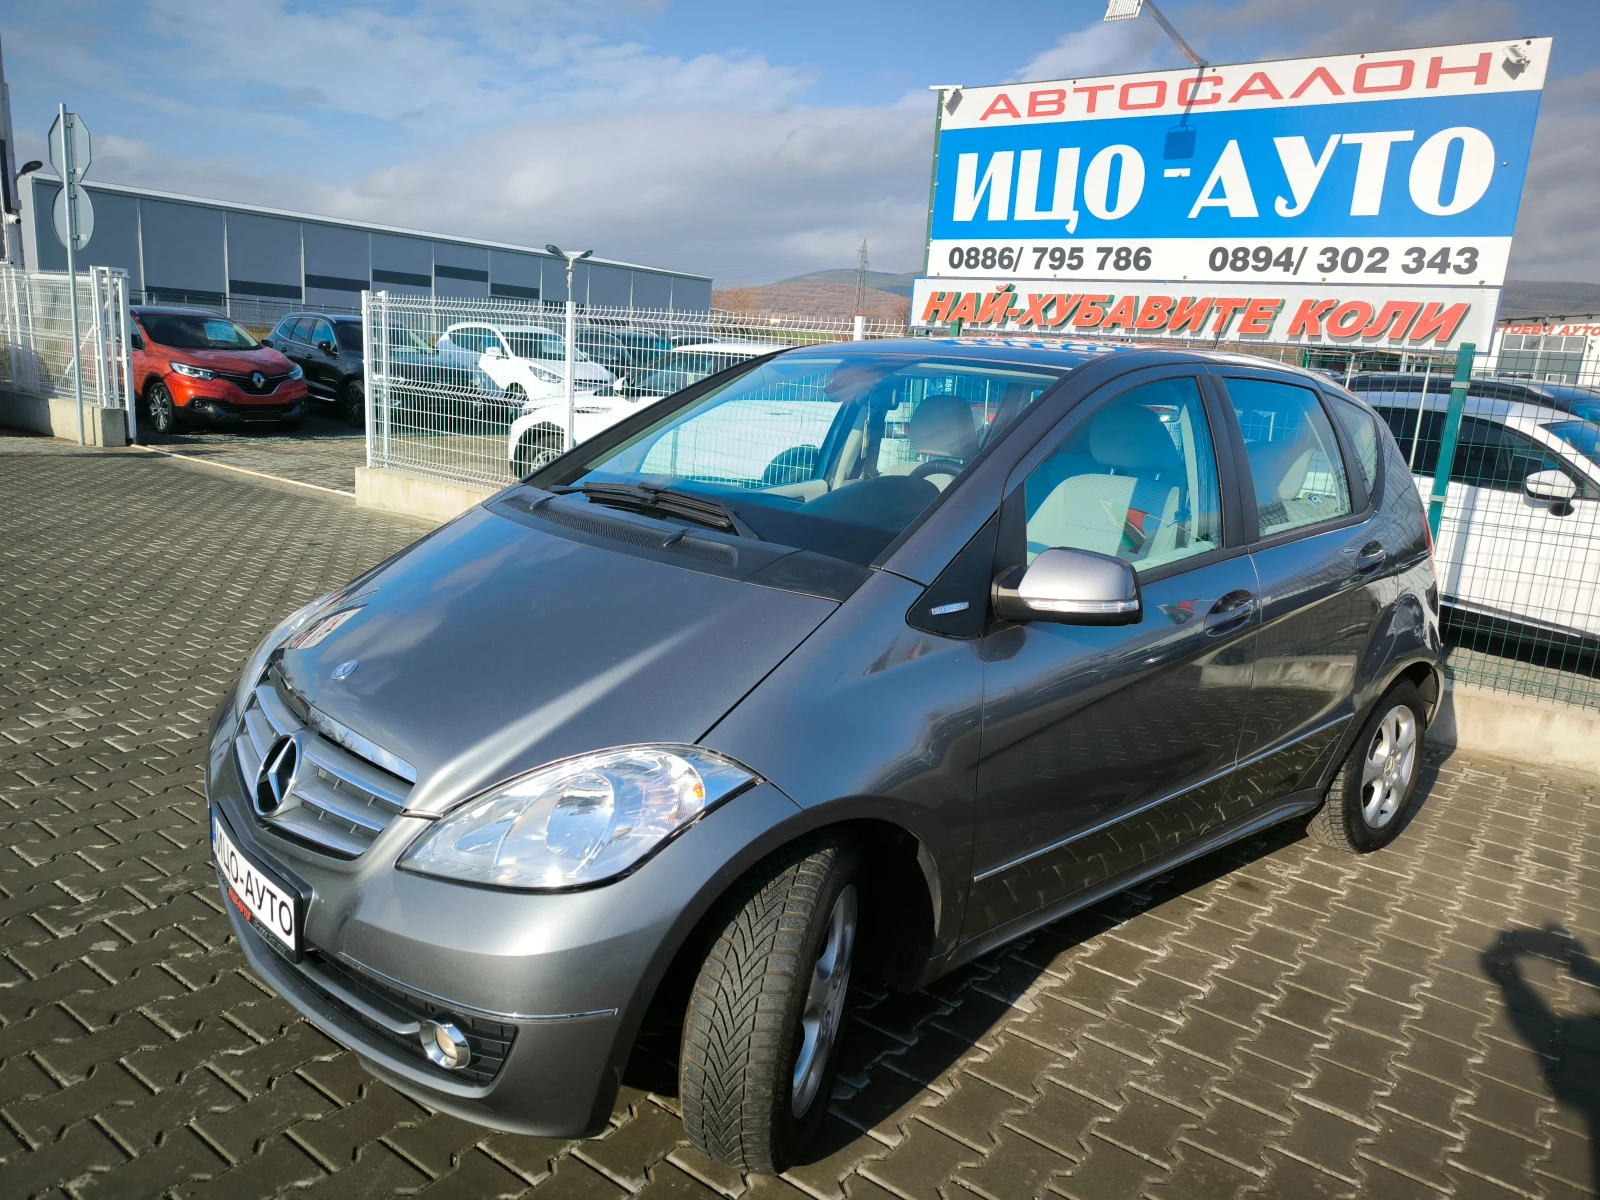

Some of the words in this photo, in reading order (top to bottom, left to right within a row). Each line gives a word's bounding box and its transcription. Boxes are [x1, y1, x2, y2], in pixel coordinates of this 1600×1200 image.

[979, 52, 1492, 121] АВТОСАЛОН
[949, 246, 1024, 272] 0886/
[1032, 247, 1084, 270] 795
[1096, 247, 1152, 271] 786
[1208, 246, 1308, 275] 0894/
[1316, 246, 1390, 274] 302
[1401, 246, 1480, 275] 343
[921, 283, 1285, 335] НАЙ-ХУБАВИТЕ
[1286, 298, 1471, 342] КОЛИ
[216, 825, 293, 937] ИЦО-АУТО
